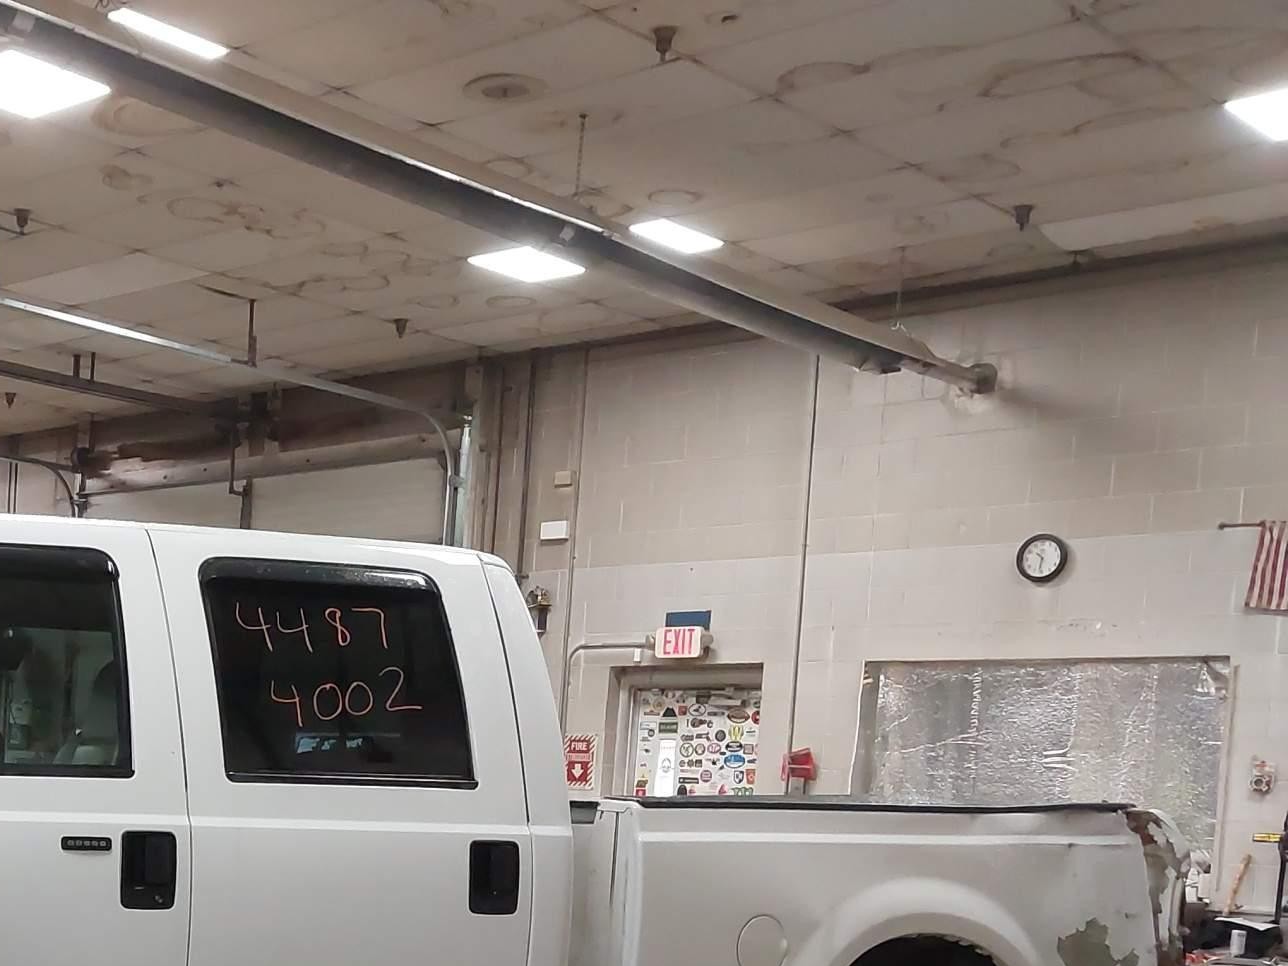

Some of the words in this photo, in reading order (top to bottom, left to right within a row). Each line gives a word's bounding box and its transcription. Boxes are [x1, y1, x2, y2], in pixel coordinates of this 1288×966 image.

[236, 601, 389, 653] 4487
[663, 628, 695, 655] EXIT
[270, 666, 423, 728] 4002
[571, 741, 588, 751] FIRE
